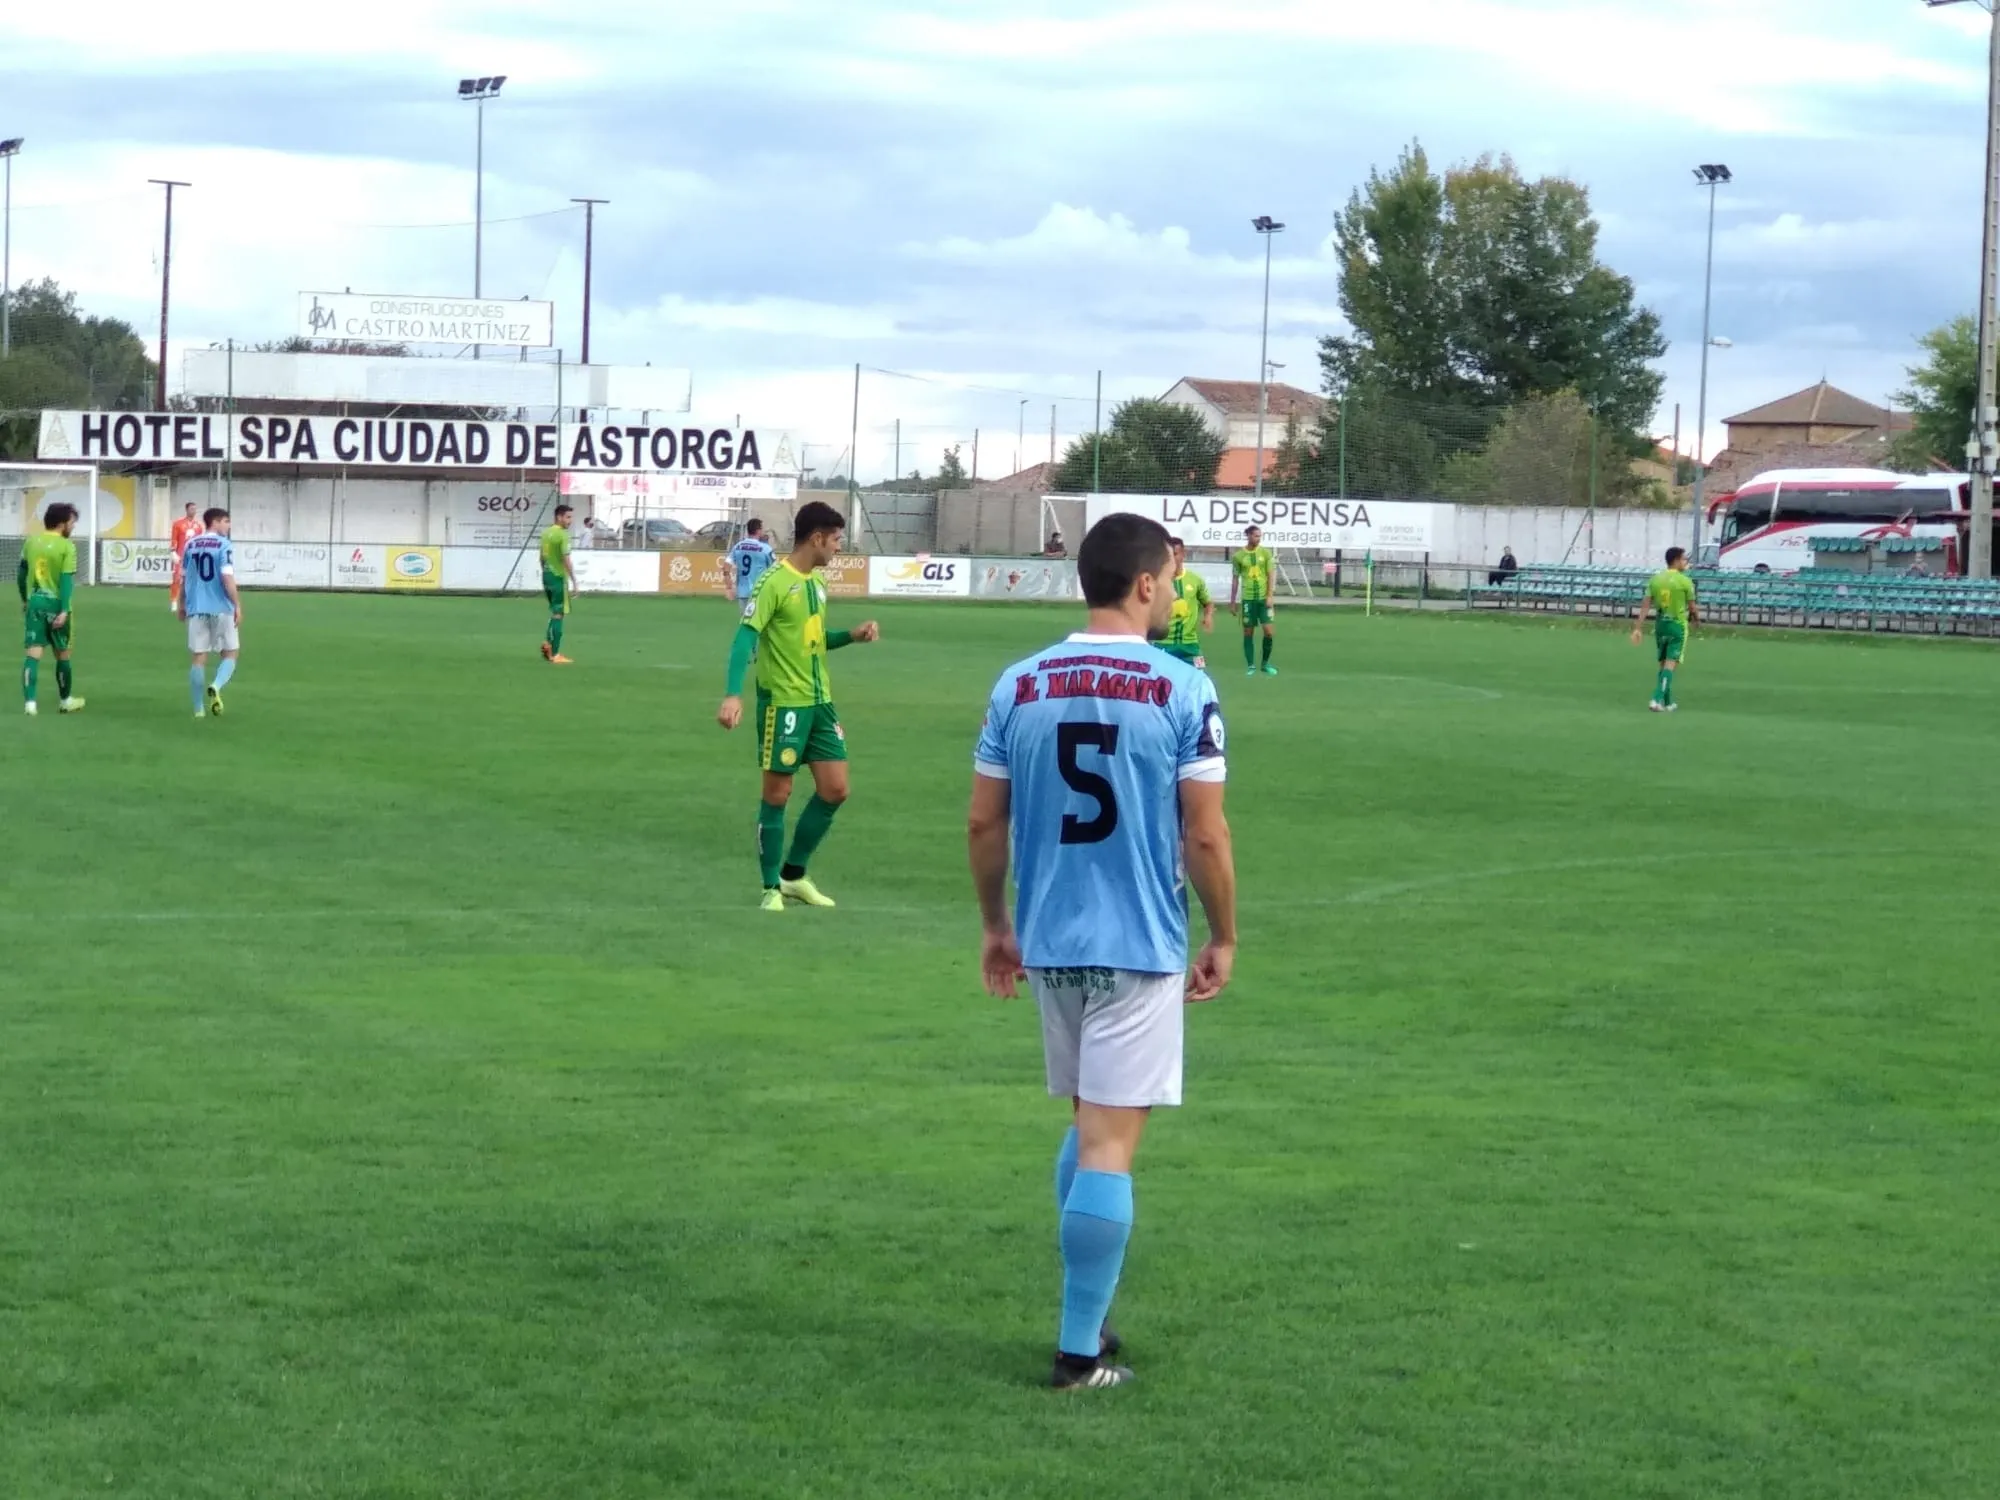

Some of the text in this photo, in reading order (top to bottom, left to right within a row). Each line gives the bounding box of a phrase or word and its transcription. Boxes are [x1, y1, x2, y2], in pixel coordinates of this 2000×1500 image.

[370, 300, 505, 318] CONSTRUCCIONES
[345, 318, 532, 342] CASTRO MARTÍNEZ
[81, 413, 762, 471] HOTEL SPA CIUDAD DE ASTORGA
[1162, 498, 1372, 528] LA DESPENSA
[1202, 528, 1222, 541] de
[1263, 531, 1332, 545] maragata
[191, 551, 215, 582] 10
[742, 554, 753, 577] 9
[923, 563, 955, 581] GLS
[1014, 669, 1173, 707] EL MARAGATO
[784, 711, 797, 735] 9
[1057, 722, 1119, 845] 5
